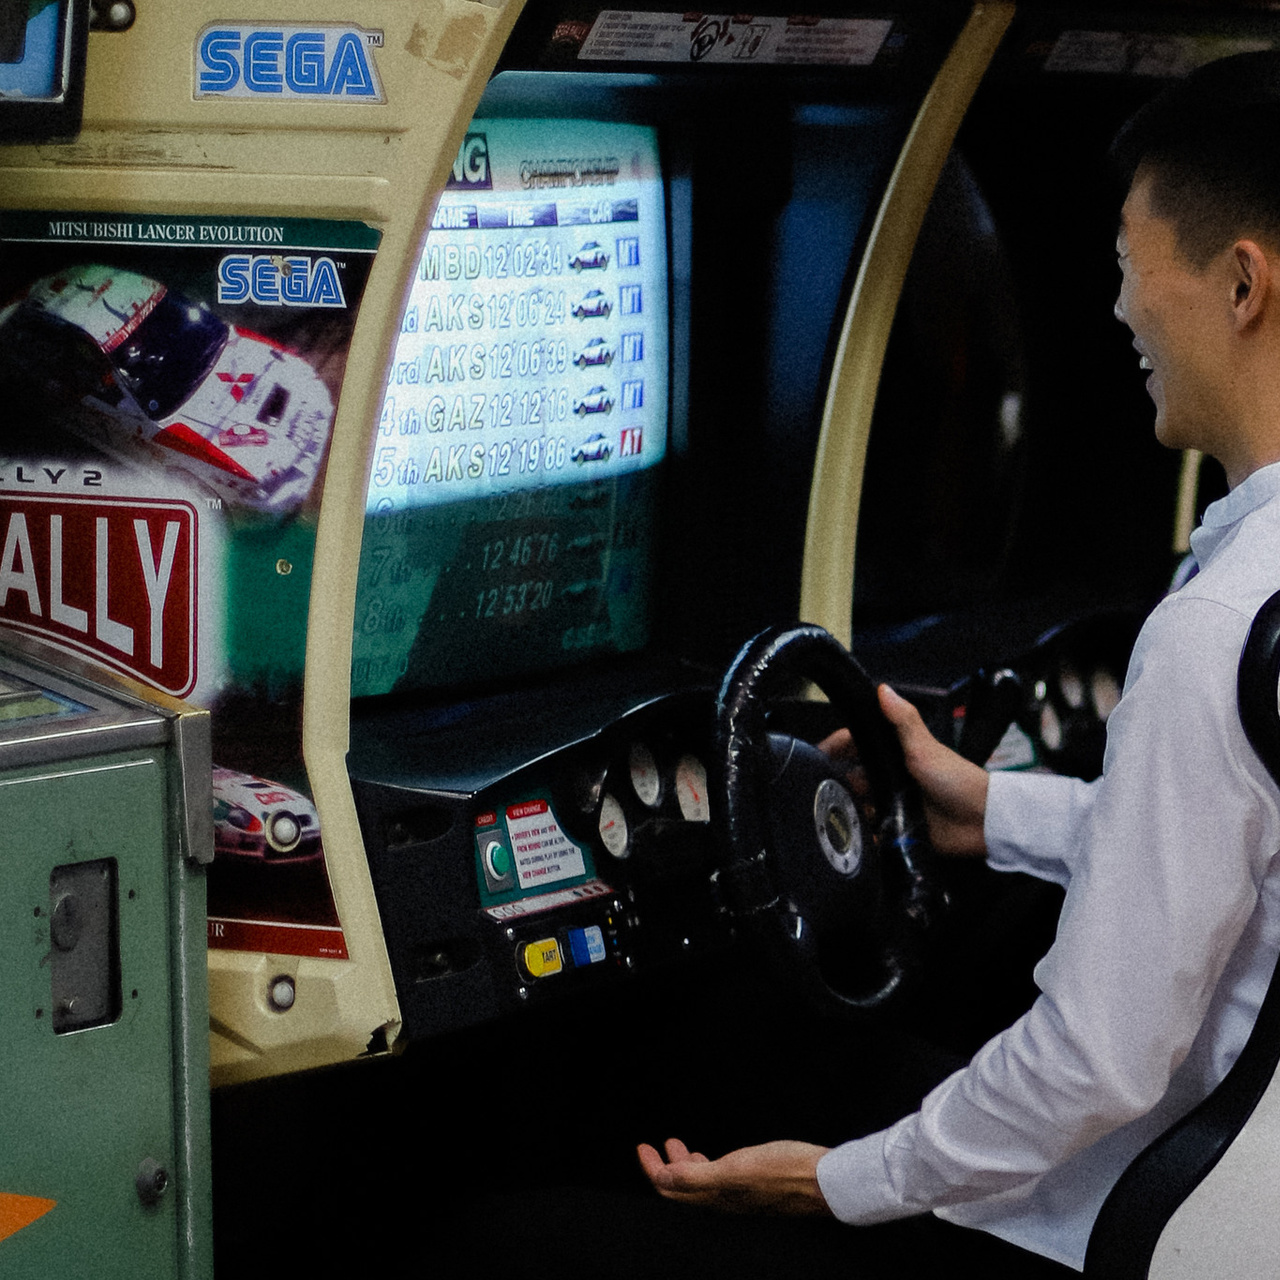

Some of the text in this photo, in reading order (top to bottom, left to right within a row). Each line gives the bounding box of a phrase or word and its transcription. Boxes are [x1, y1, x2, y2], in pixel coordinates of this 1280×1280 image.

[200, 31, 376, 95] SEGA
[49, 221, 284, 242] MITSUBISHI LANCER EVOLUTION
[218, 254, 347, 309] SEGA
